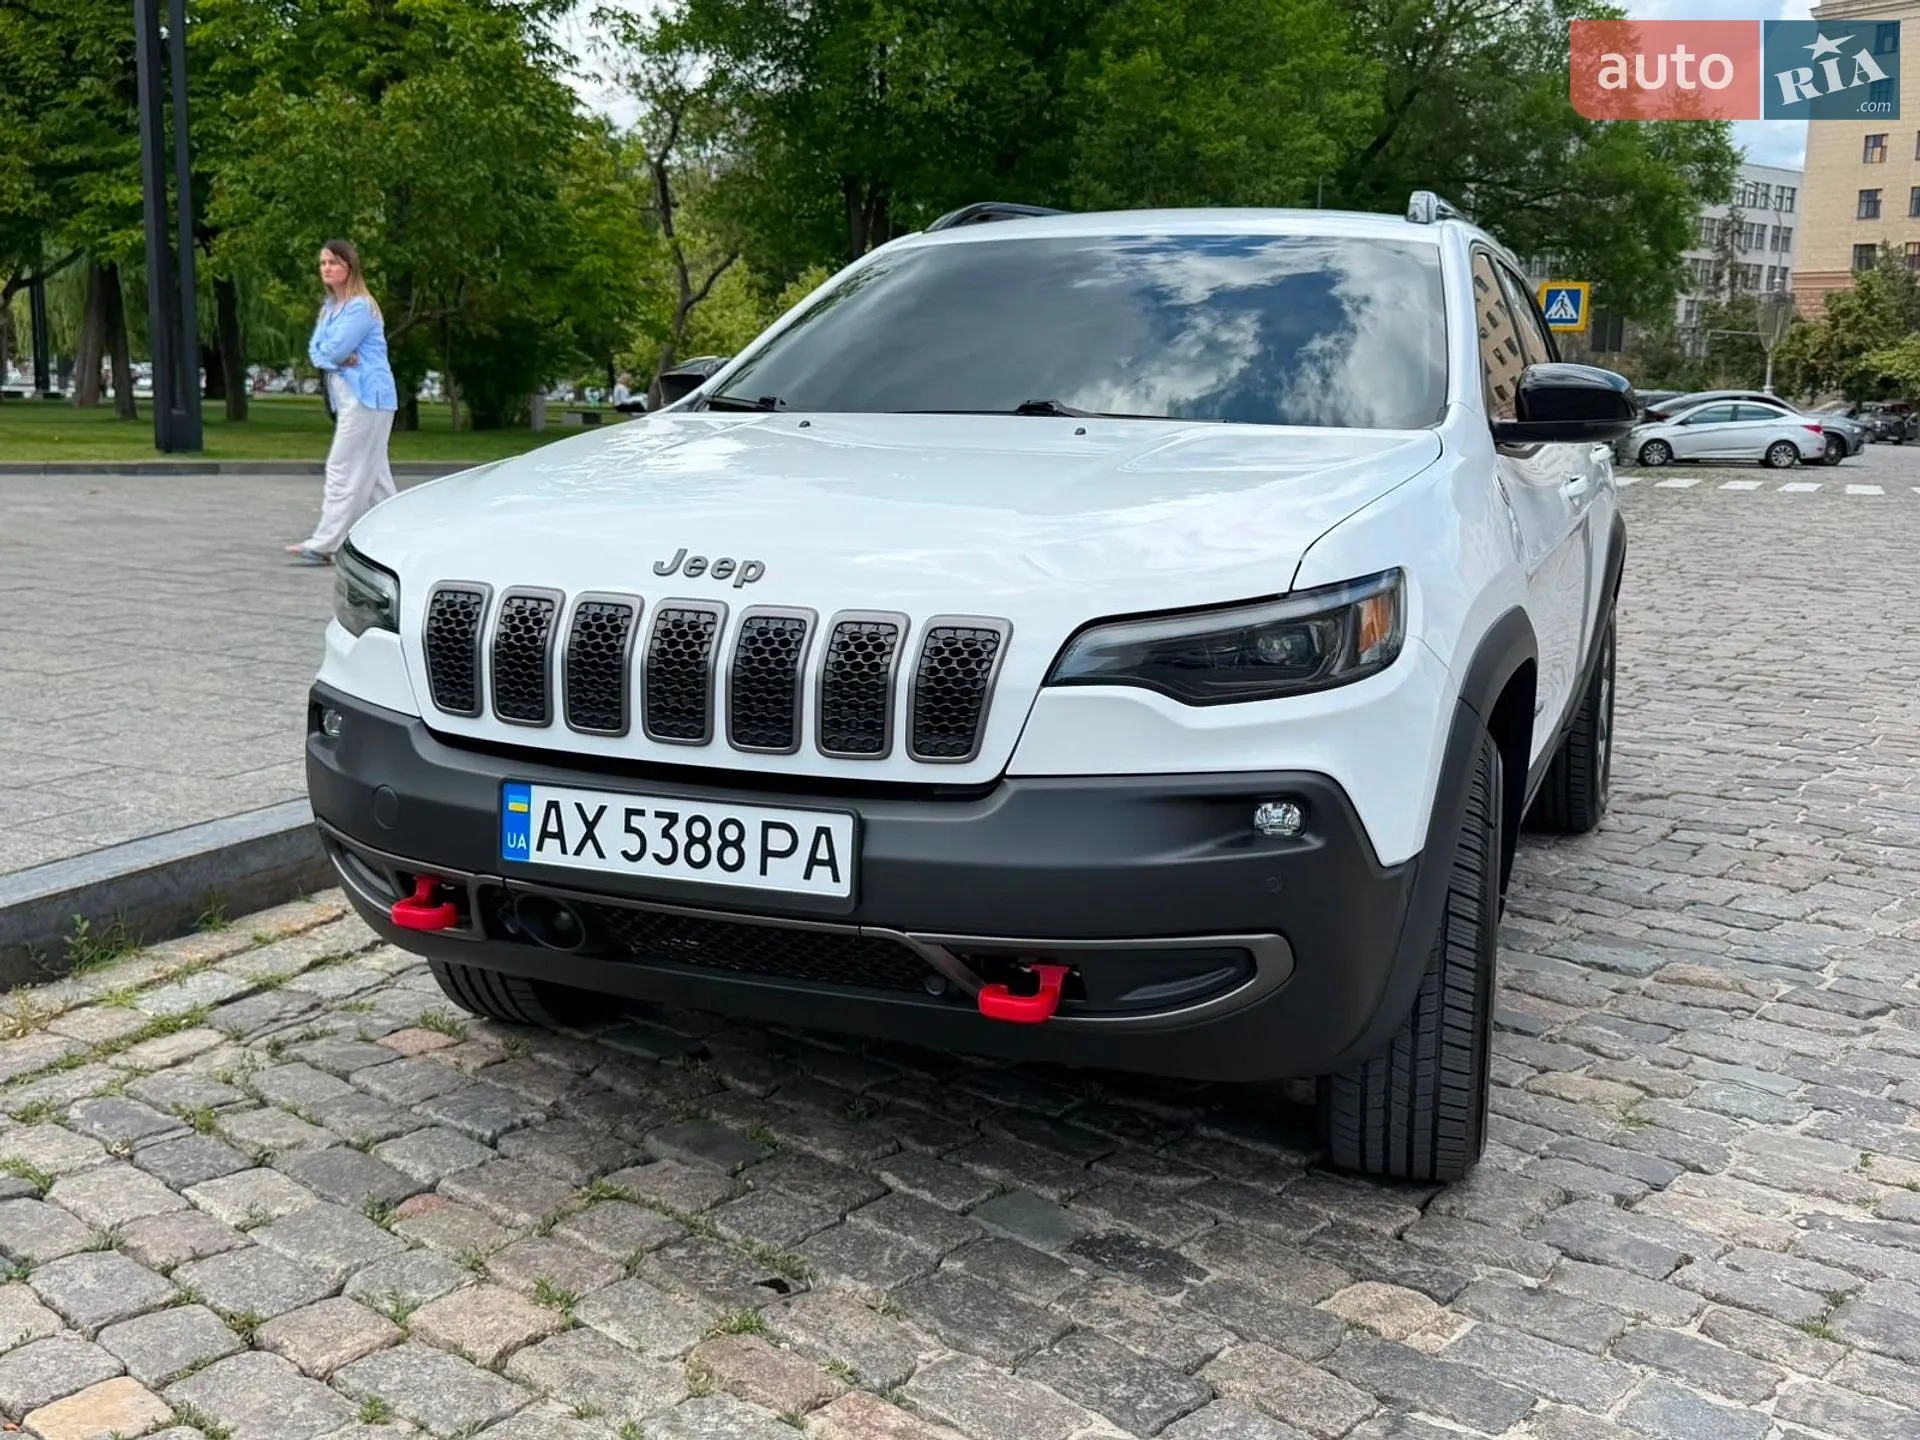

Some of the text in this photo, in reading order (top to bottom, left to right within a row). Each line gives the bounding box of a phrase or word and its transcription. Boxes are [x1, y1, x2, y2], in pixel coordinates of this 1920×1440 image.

[653, 548, 766, 589] Jeep
[507, 831, 527, 850] UA
[535, 800, 841, 883] AX 5388 PA
